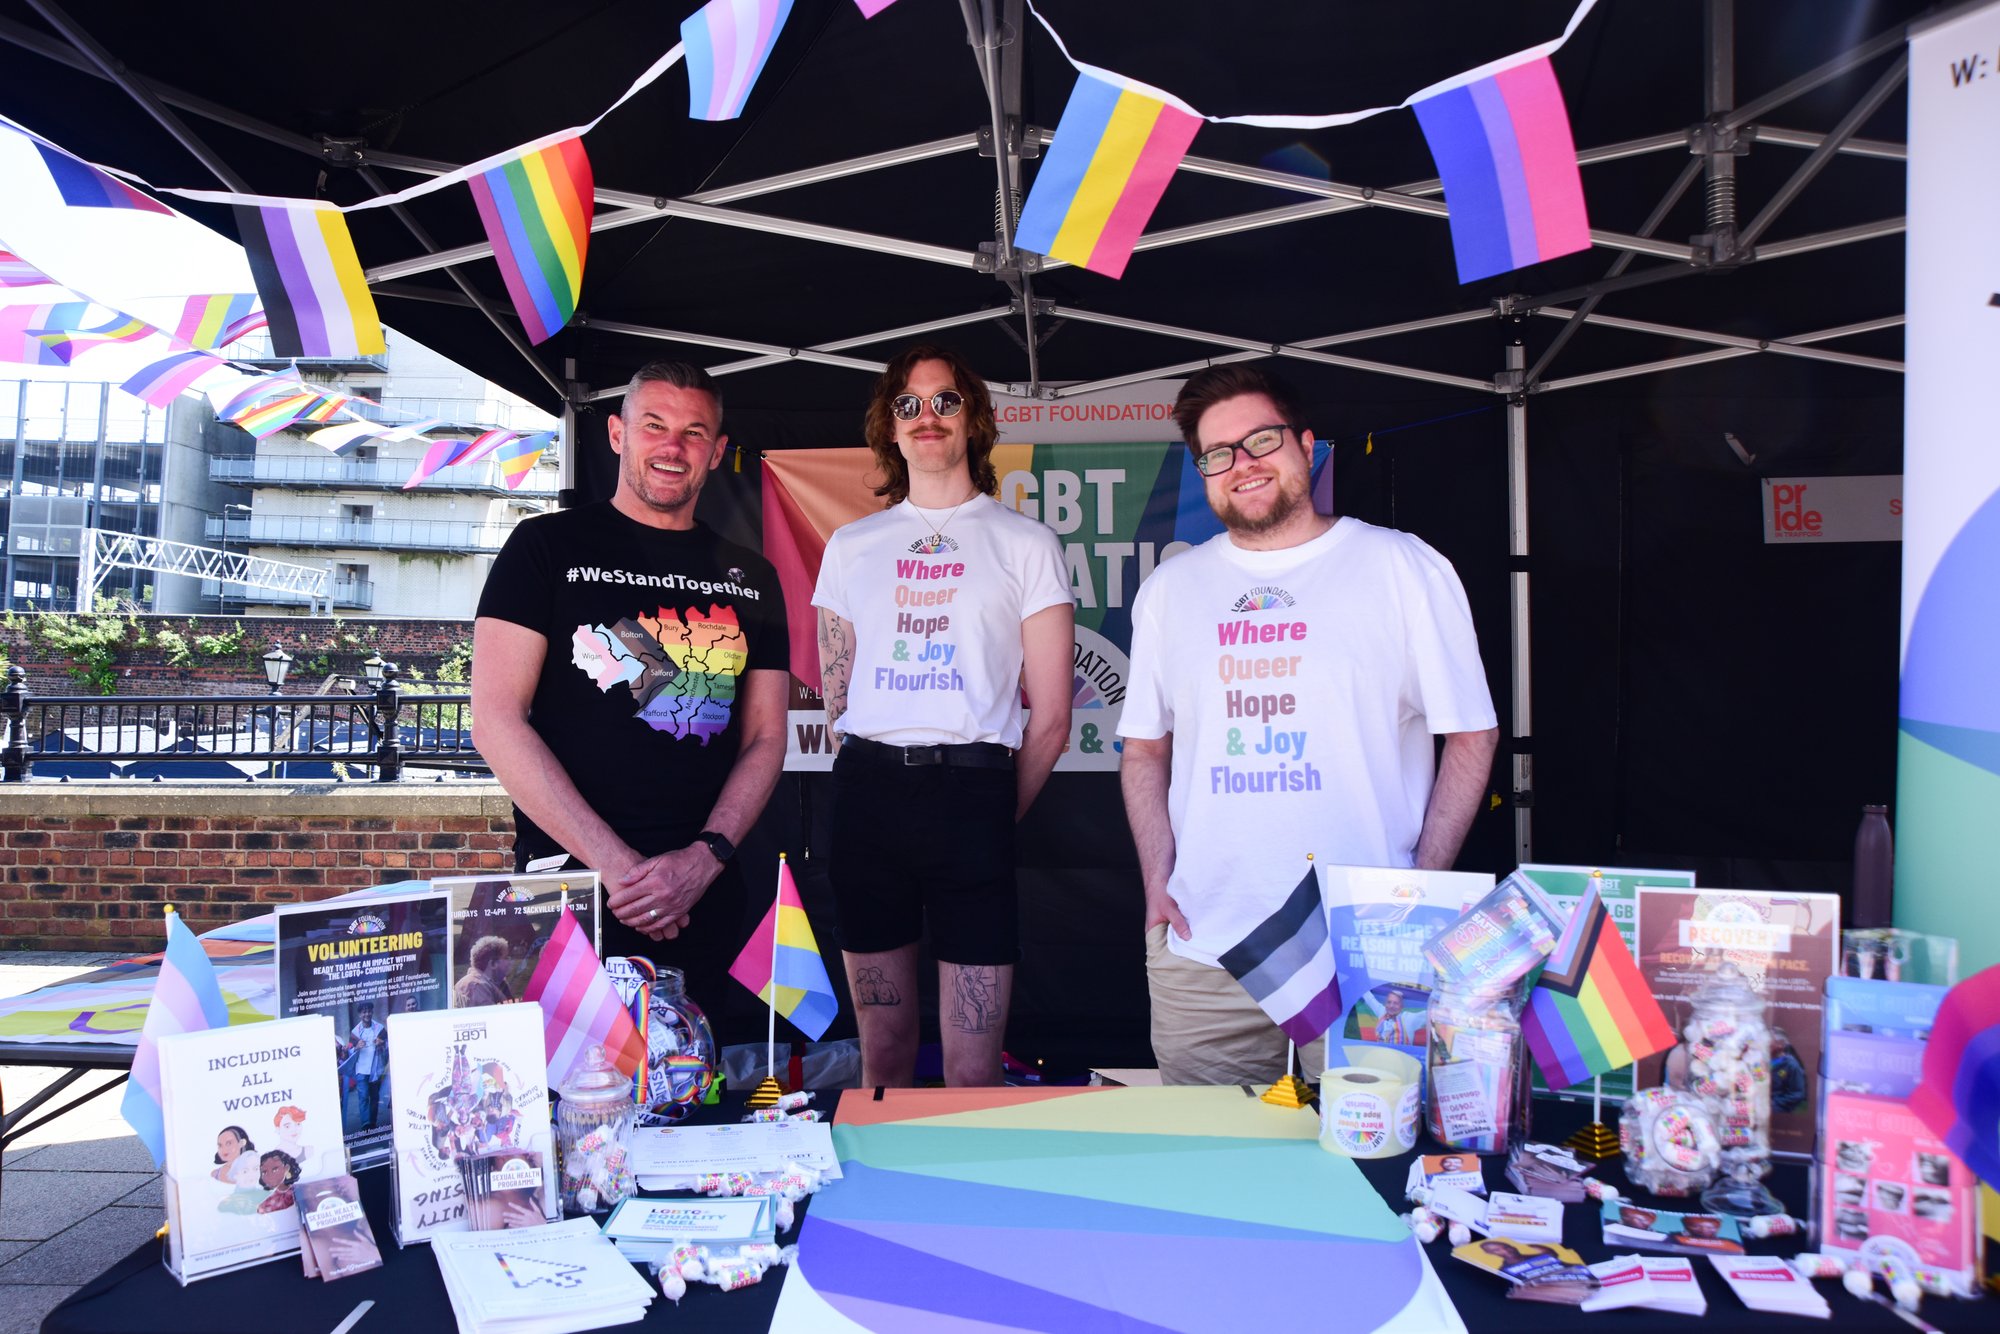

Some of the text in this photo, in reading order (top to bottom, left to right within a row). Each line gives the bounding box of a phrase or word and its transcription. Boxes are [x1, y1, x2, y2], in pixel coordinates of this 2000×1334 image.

[994, 405, 1044, 423] LGBT
[908, 534, 960, 553] LGBT FODATION
[896, 559, 965, 580] Where
[566, 566, 761, 601] #WeStandTogether
[895, 584, 958, 608] Queer
[1231, 586, 1297, 612] LGBT FOUNDATION
[664, 624, 679, 632] Bury
[698, 622, 727, 632] Rochdale
[896, 612, 950, 639] Hope
[1217, 619, 1308, 646] Where
[620, 630, 644, 639] Bolton
[582, 652, 602, 661] Wigan
[892, 639, 956, 666] & Joy
[650, 668, 674, 677] Salford
[1218, 654, 1302, 684] Queer
[874, 666, 965, 692] Flourish
[685, 672, 700, 711] Manchester
[798, 686, 813, 699] W:
[642, 708, 668, 718] Trafford
[1226, 690, 1296, 724] Hope
[702, 712, 725, 722] Stockport
[1079, 722, 1104, 754] &
[1226, 726, 1308, 761] & Joy
[1210, 762, 1322, 795] Flourish
[484, 908, 506, 916] 12-4PM
[522, 904, 556, 914] SACKVILLE
[346, 914, 386, 935] LGBT FOUNDATION
[308, 931, 424, 962] VOLUNTEERING
[1341, 935, 1397, 954] REASON
[313, 954, 417, 975] READY TO MAKE AN IMPACT WITHIN
[1350, 954, 1364, 968] IN
[1368, 956, 1394, 970] THE
[328, 964, 404, 980] THE LGBTQ+ COMMUNITY?
[363, 979, 386, 987] volunteers
[306, 1002, 325, 1010] connect
[454, 1028, 487, 1042] LGBT
[208, 1046, 301, 1072] INCLUDING
[241, 1071, 273, 1088] ALL
[222, 1088, 294, 1112] WOMEN
[518, 1092, 544, 1108] PETITION
[1345, 1101, 1376, 1110] Flourish
[1340, 1108, 1353, 1118] Joy
[1363, 1112, 1382, 1120] Hope
[1361, 1122, 1384, 1130] Where
[1371, 1131, 1386, 1148] LGBT
[492, 1170, 540, 1181] SEXUAL HEALTH
[498, 1179, 535, 1188] PROGRAMME
[308, 1204, 360, 1223] SEXUAL HEALTH
[316, 1212, 356, 1228] PROGRAMME
